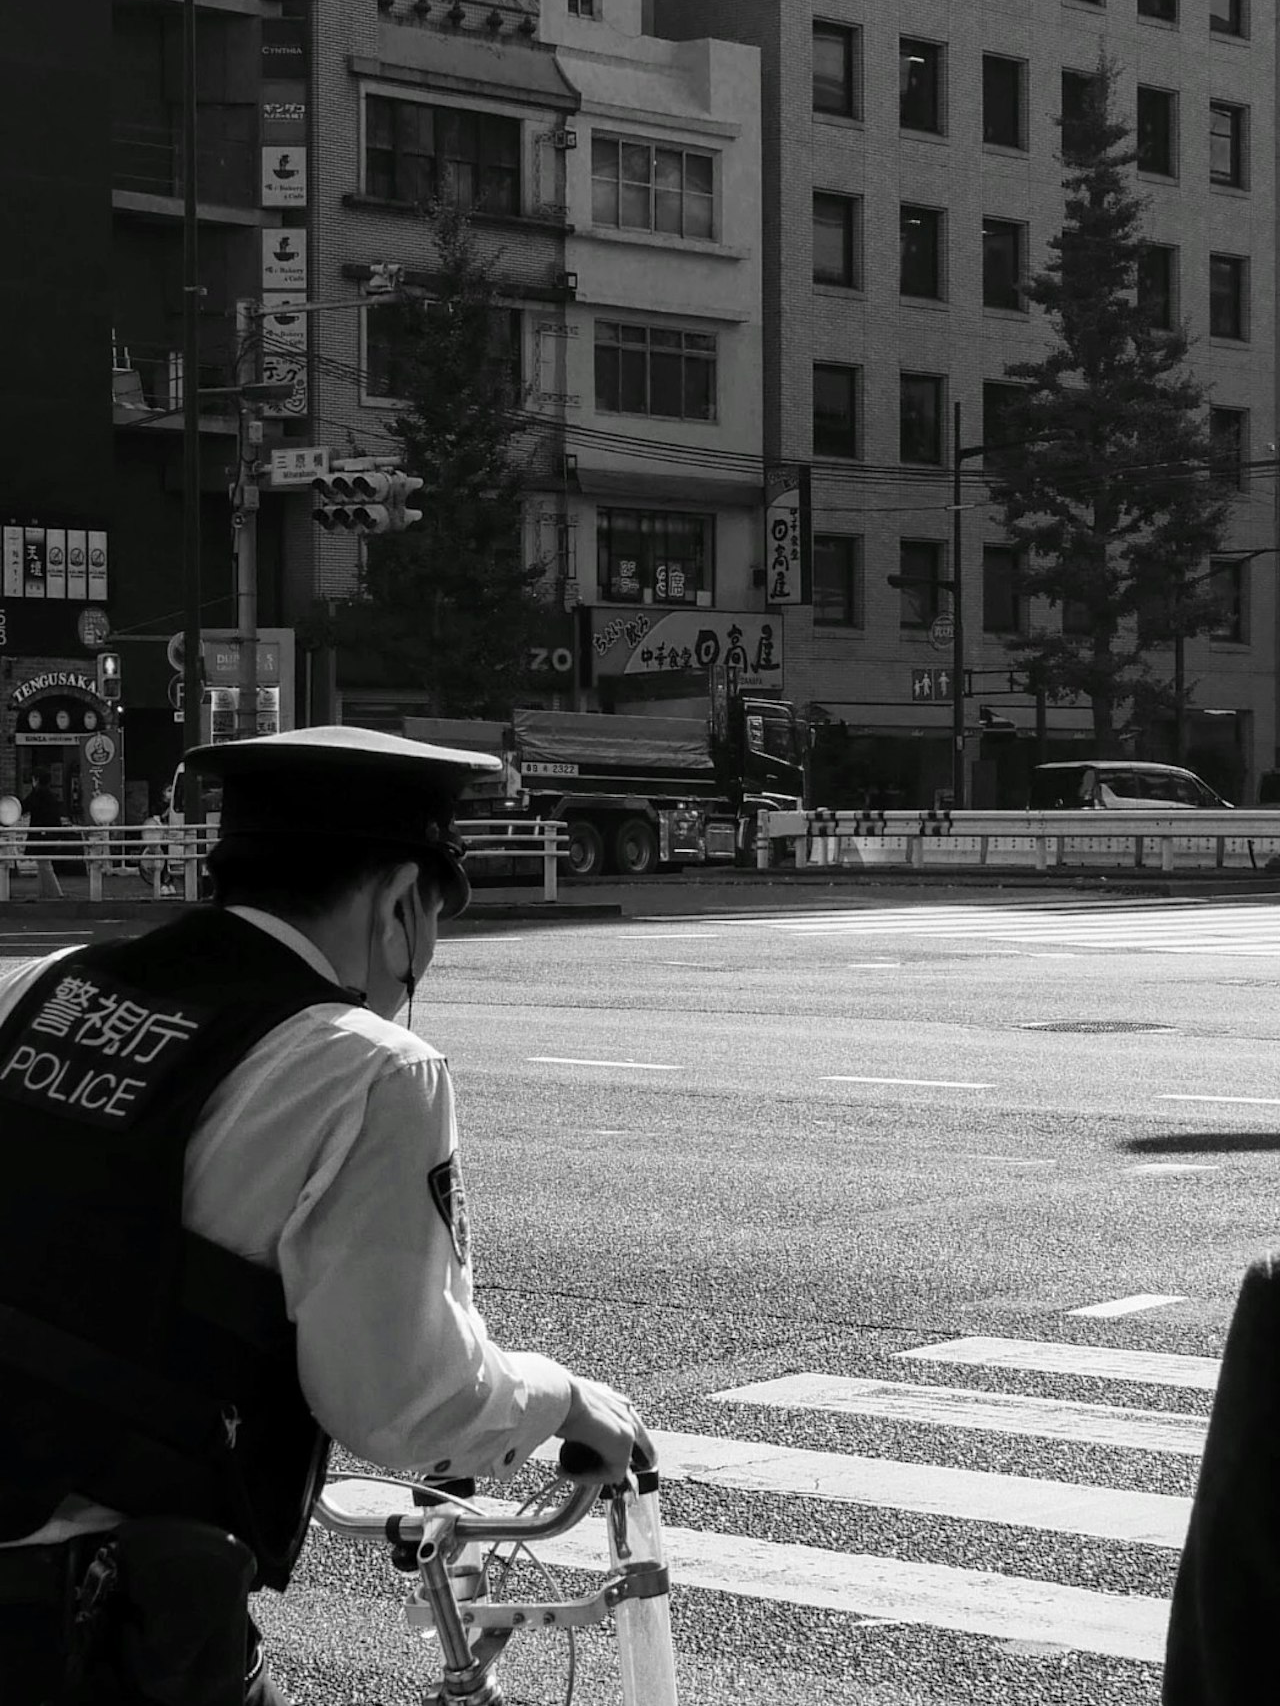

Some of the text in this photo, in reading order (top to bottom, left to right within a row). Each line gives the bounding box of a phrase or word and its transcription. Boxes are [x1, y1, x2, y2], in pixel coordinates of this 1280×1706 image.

[261, 45, 303, 55] CYNTHIA
[640, 624, 780, 674] 中華食堂 日高屋
[552, 764, 575, 774] 2322
[31, 974, 199, 1063] 警視庁
[0, 1045, 147, 1116] POLICE
